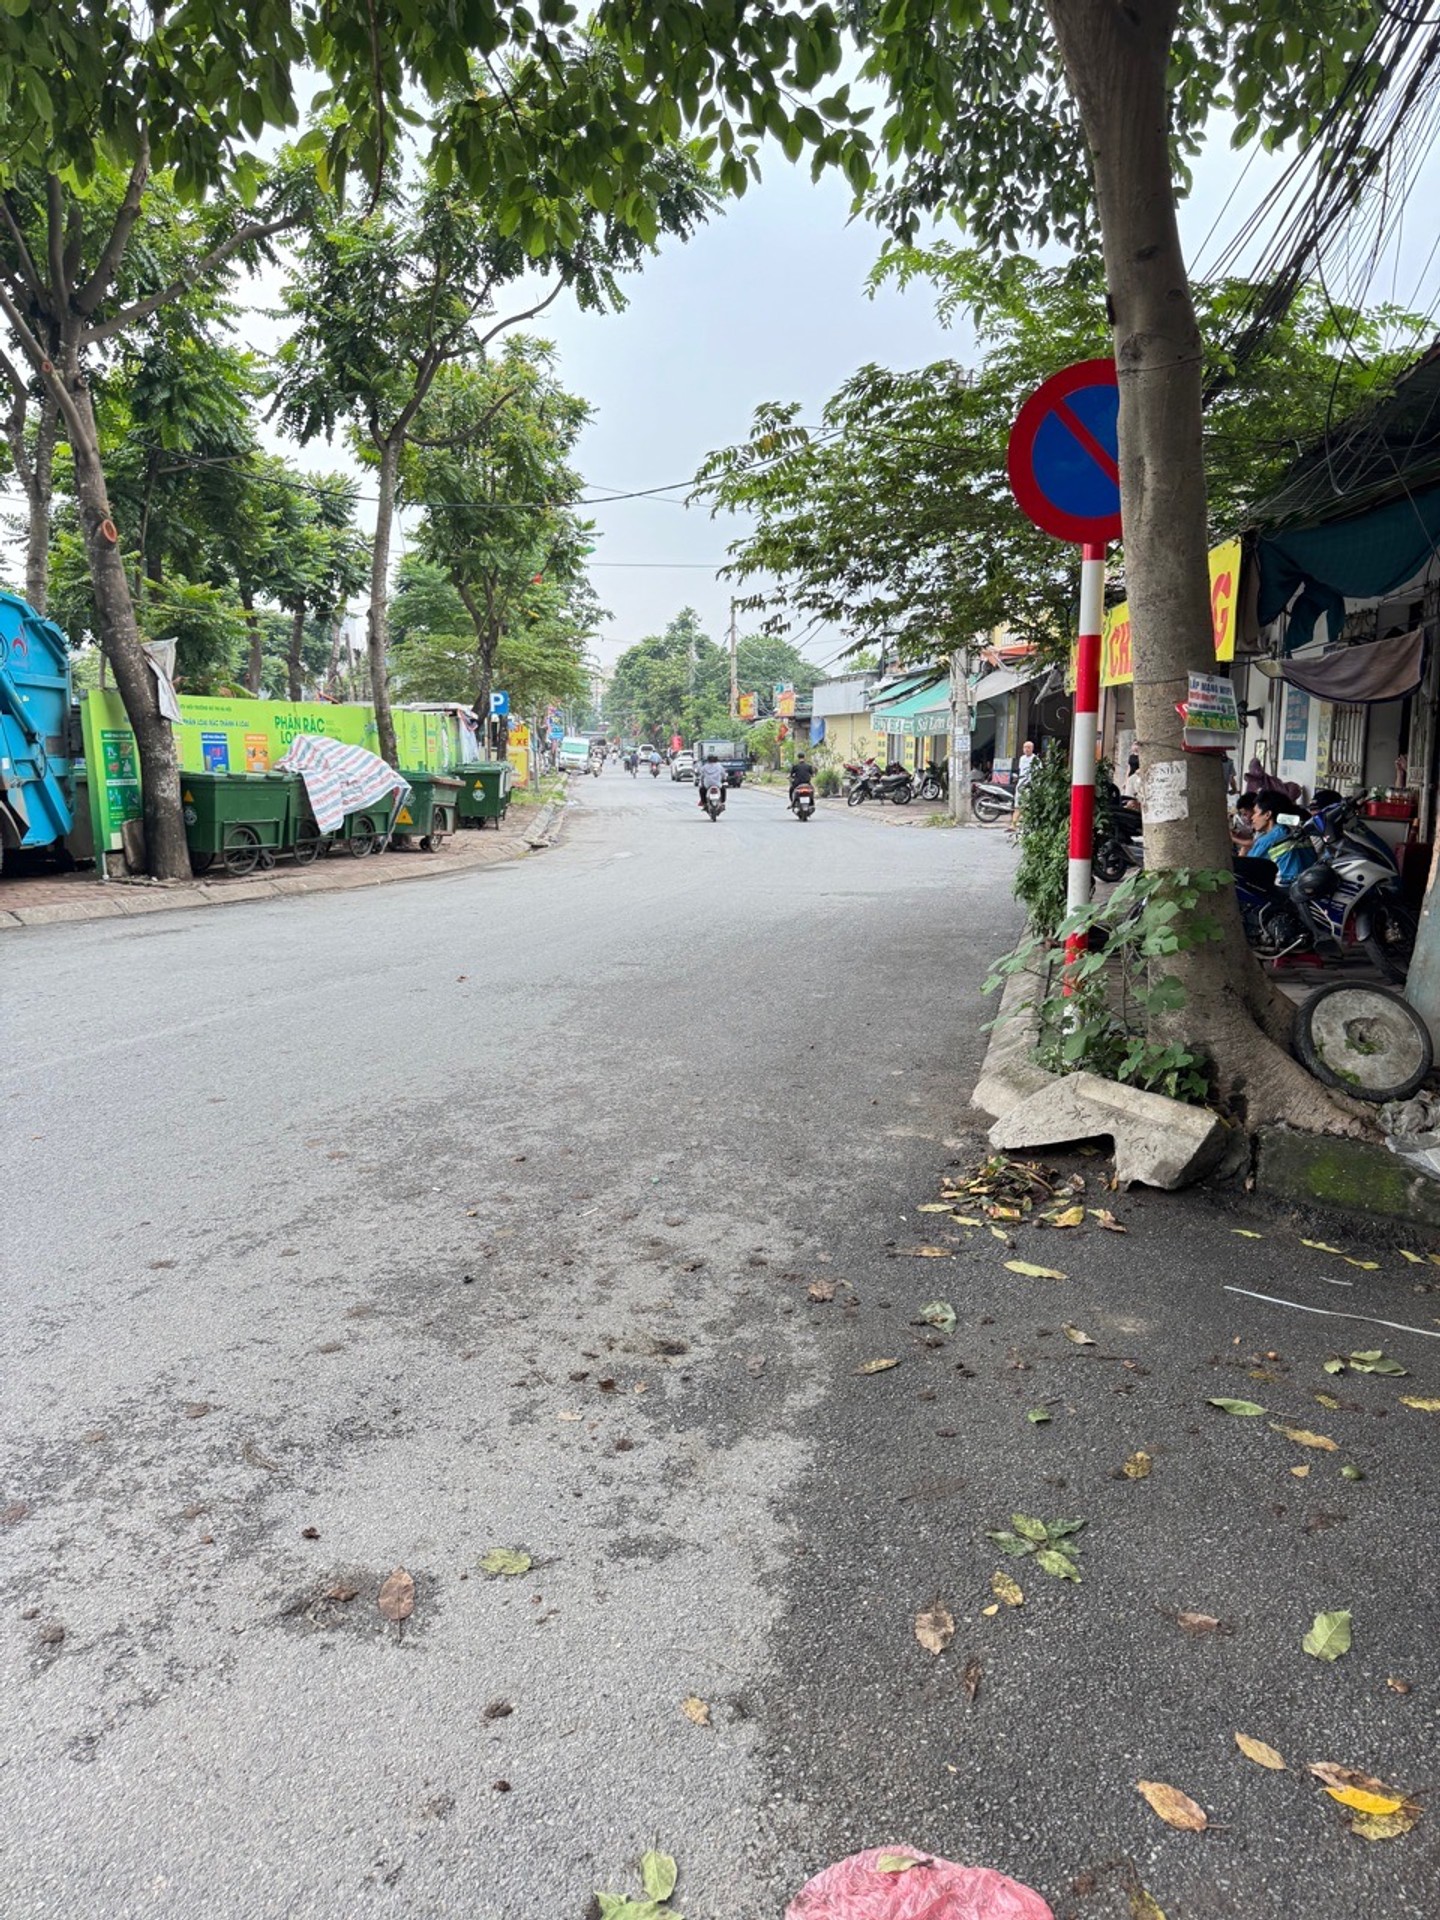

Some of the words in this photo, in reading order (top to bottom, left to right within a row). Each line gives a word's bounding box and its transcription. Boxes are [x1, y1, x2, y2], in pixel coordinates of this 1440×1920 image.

[1211, 571, 1231, 652] G
[490, 692, 504, 713] P
[274, 713, 301, 730] PHÂN
[303, 714, 325, 733] RÁC
